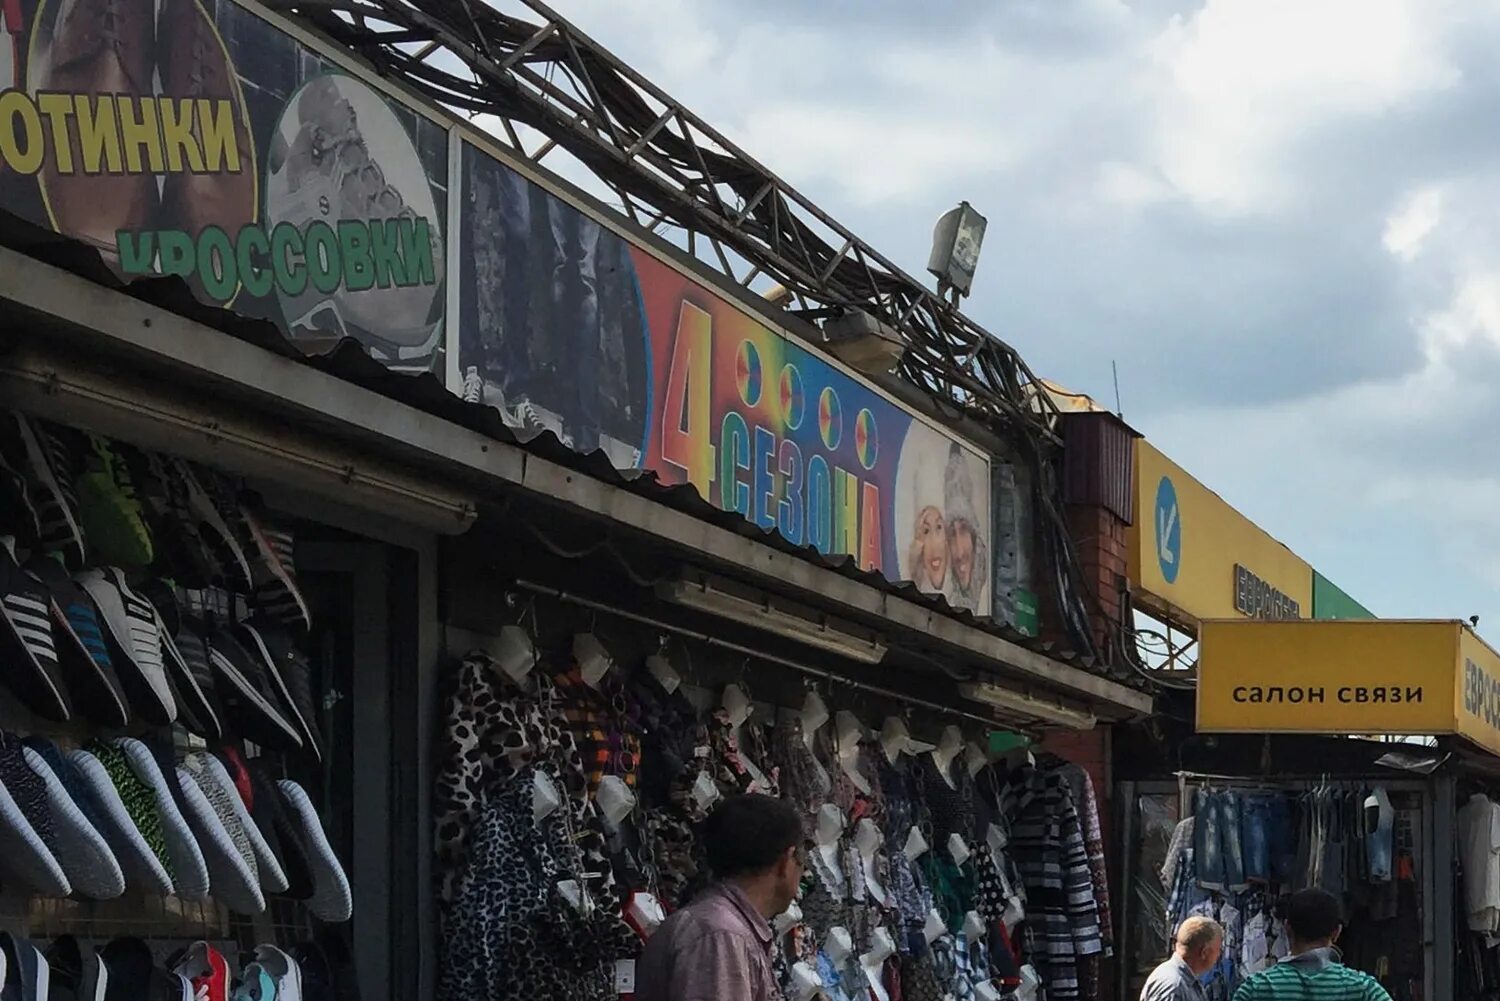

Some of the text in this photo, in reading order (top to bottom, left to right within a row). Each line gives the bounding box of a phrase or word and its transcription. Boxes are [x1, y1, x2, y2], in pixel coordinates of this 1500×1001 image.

[116, 216, 436, 300] КРОССОВКИ
[662, 299, 883, 572] 4 СЕЗОНА
[1232, 686, 1422, 703] салон связи
